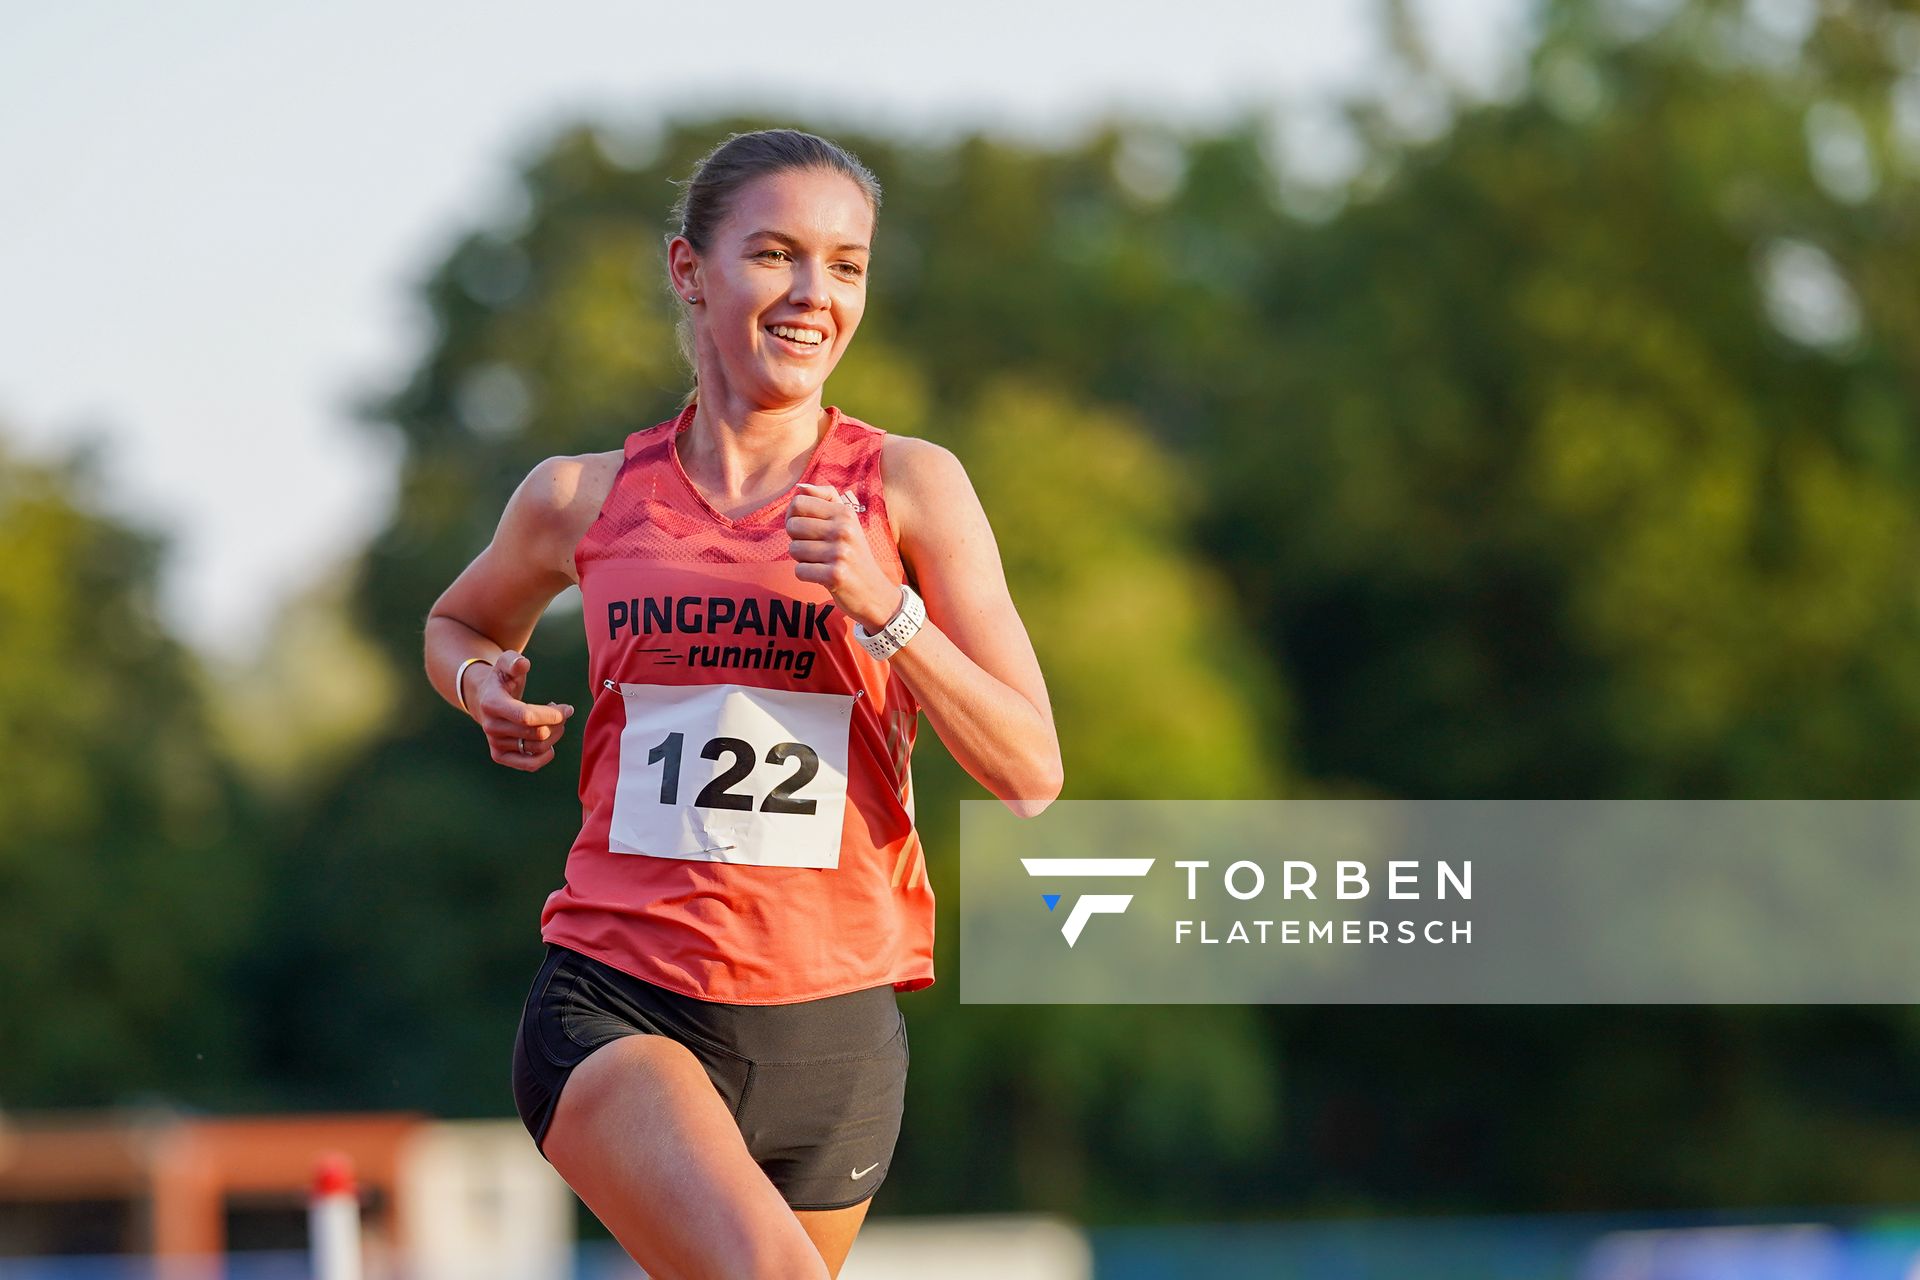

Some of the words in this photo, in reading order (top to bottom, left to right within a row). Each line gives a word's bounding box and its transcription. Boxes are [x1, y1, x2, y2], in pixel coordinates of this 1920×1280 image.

[608, 596, 835, 641] PINGPANK
[688, 641, 816, 679] running
[647, 731, 820, 816] 122
